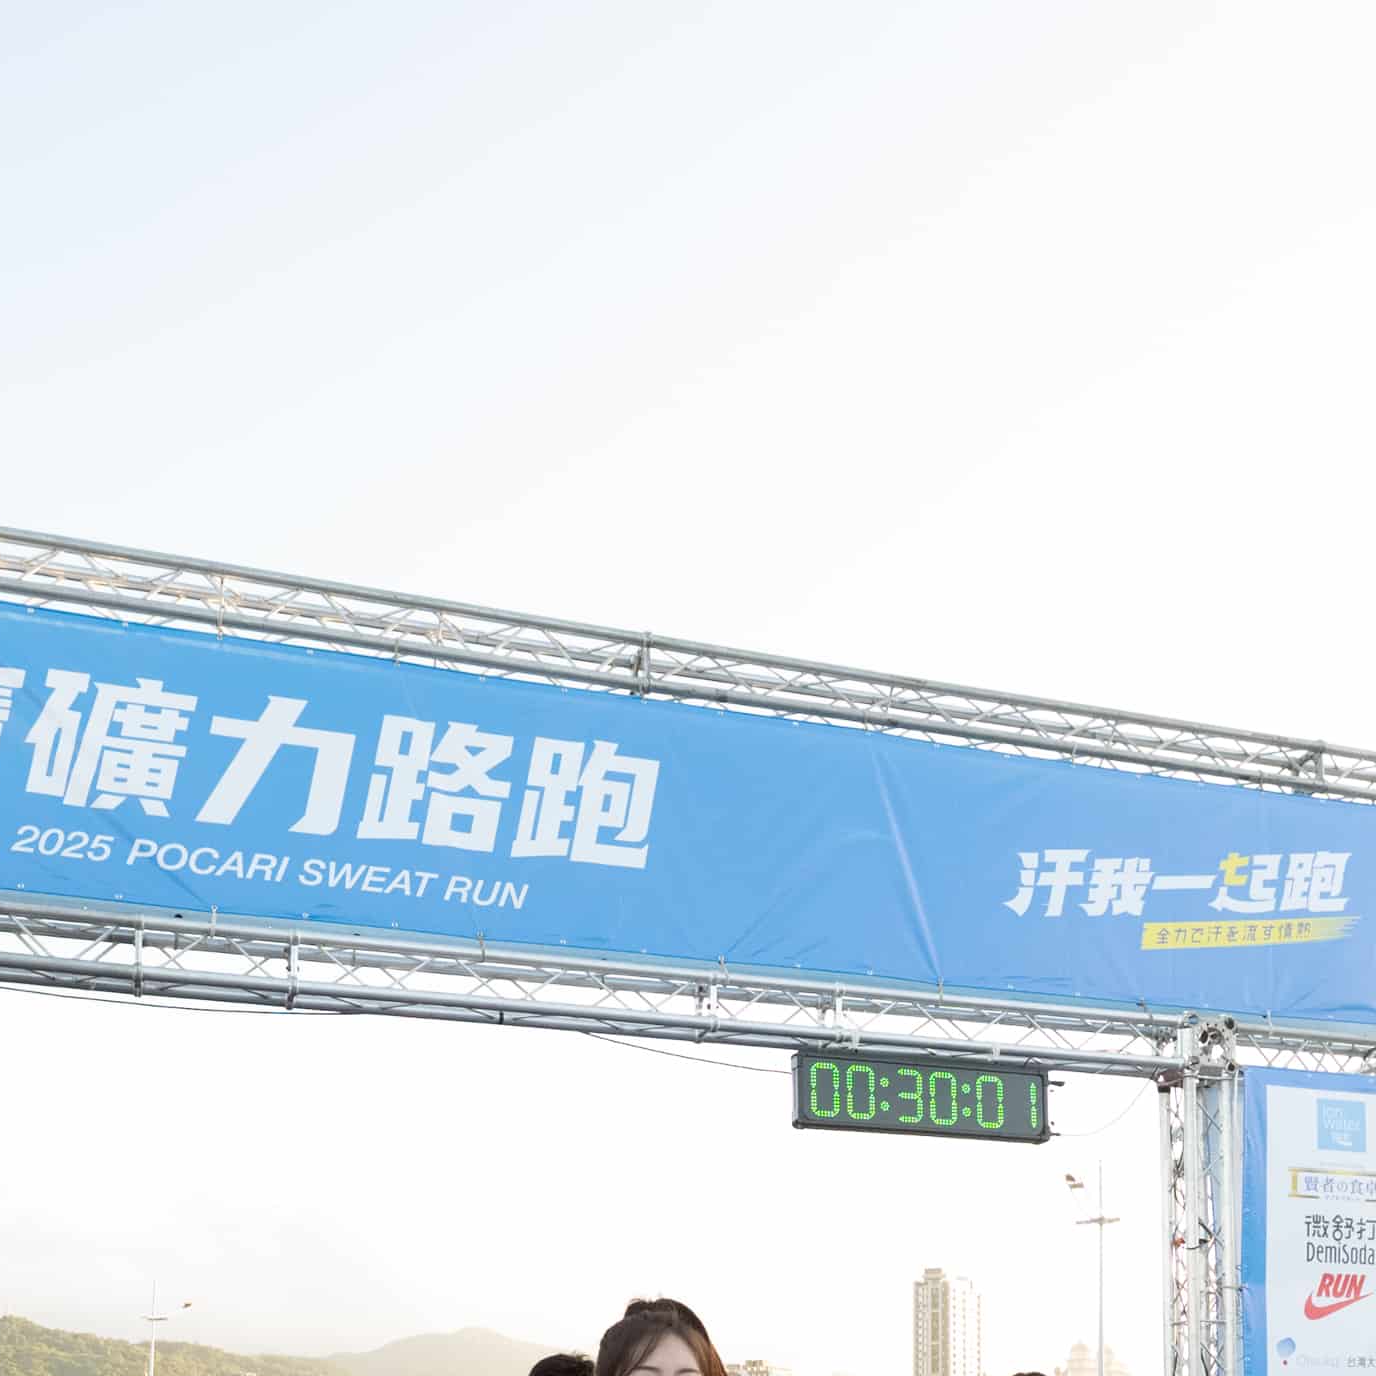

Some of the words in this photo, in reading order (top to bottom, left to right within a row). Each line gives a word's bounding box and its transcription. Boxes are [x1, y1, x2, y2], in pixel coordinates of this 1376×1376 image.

[10, 825, 114, 862] 2025
[125, 838, 289, 883] POCARI
[297, 859, 438, 899] SWEAT
[443, 876, 530, 910] RUN
[1002, 847, 1353, 918] 汗我一起跑
[810, 1061, 1039, 1130] 00:30:01
[1306, 1241, 1375, 1265] DemiSoda
[1317, 1272, 1368, 1298] RUN
